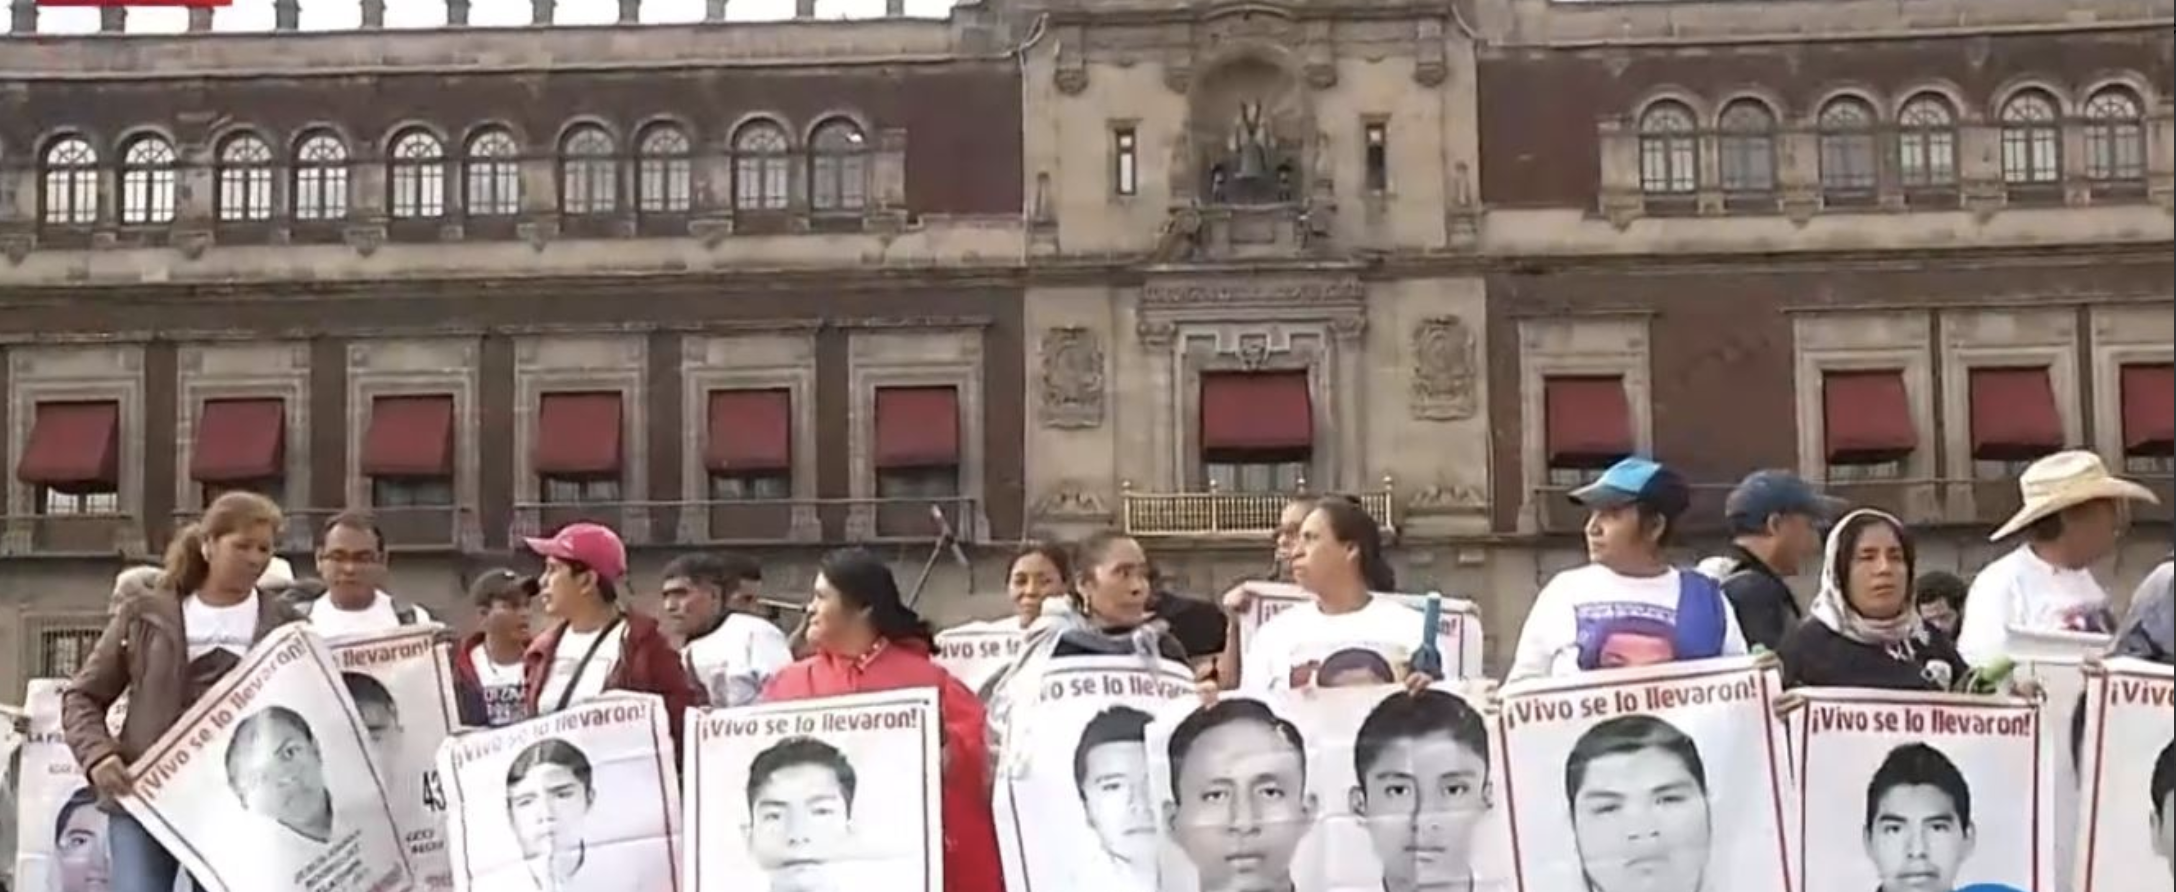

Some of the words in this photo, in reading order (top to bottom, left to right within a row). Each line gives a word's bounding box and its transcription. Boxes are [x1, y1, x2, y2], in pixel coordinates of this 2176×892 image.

[942, 642, 974, 659] ivo
[979, 642, 1001, 659] se
[1070, 677, 1097, 697] se
[1102, 674, 1124, 696] lo
[1506, 699, 1574, 729] ¡Vivo
[1582, 695, 1608, 716] se
[1614, 691, 1638, 713] lo
[1645, 675, 1759, 711] llevaron!
[189, 727, 211, 749] se
[210, 708, 233, 730] lo
[701, 717, 759, 741] ¡Vivo
[765, 718, 788, 736] se
[794, 714, 816, 734] lo
[821, 708, 918, 733] llevaron!
[1811, 706, 1869, 734] ¡Vivo
[1873, 710, 1899, 733] se
[1904, 707, 1925, 733] lo
[1931, 708, 2032, 737] llevaron!
